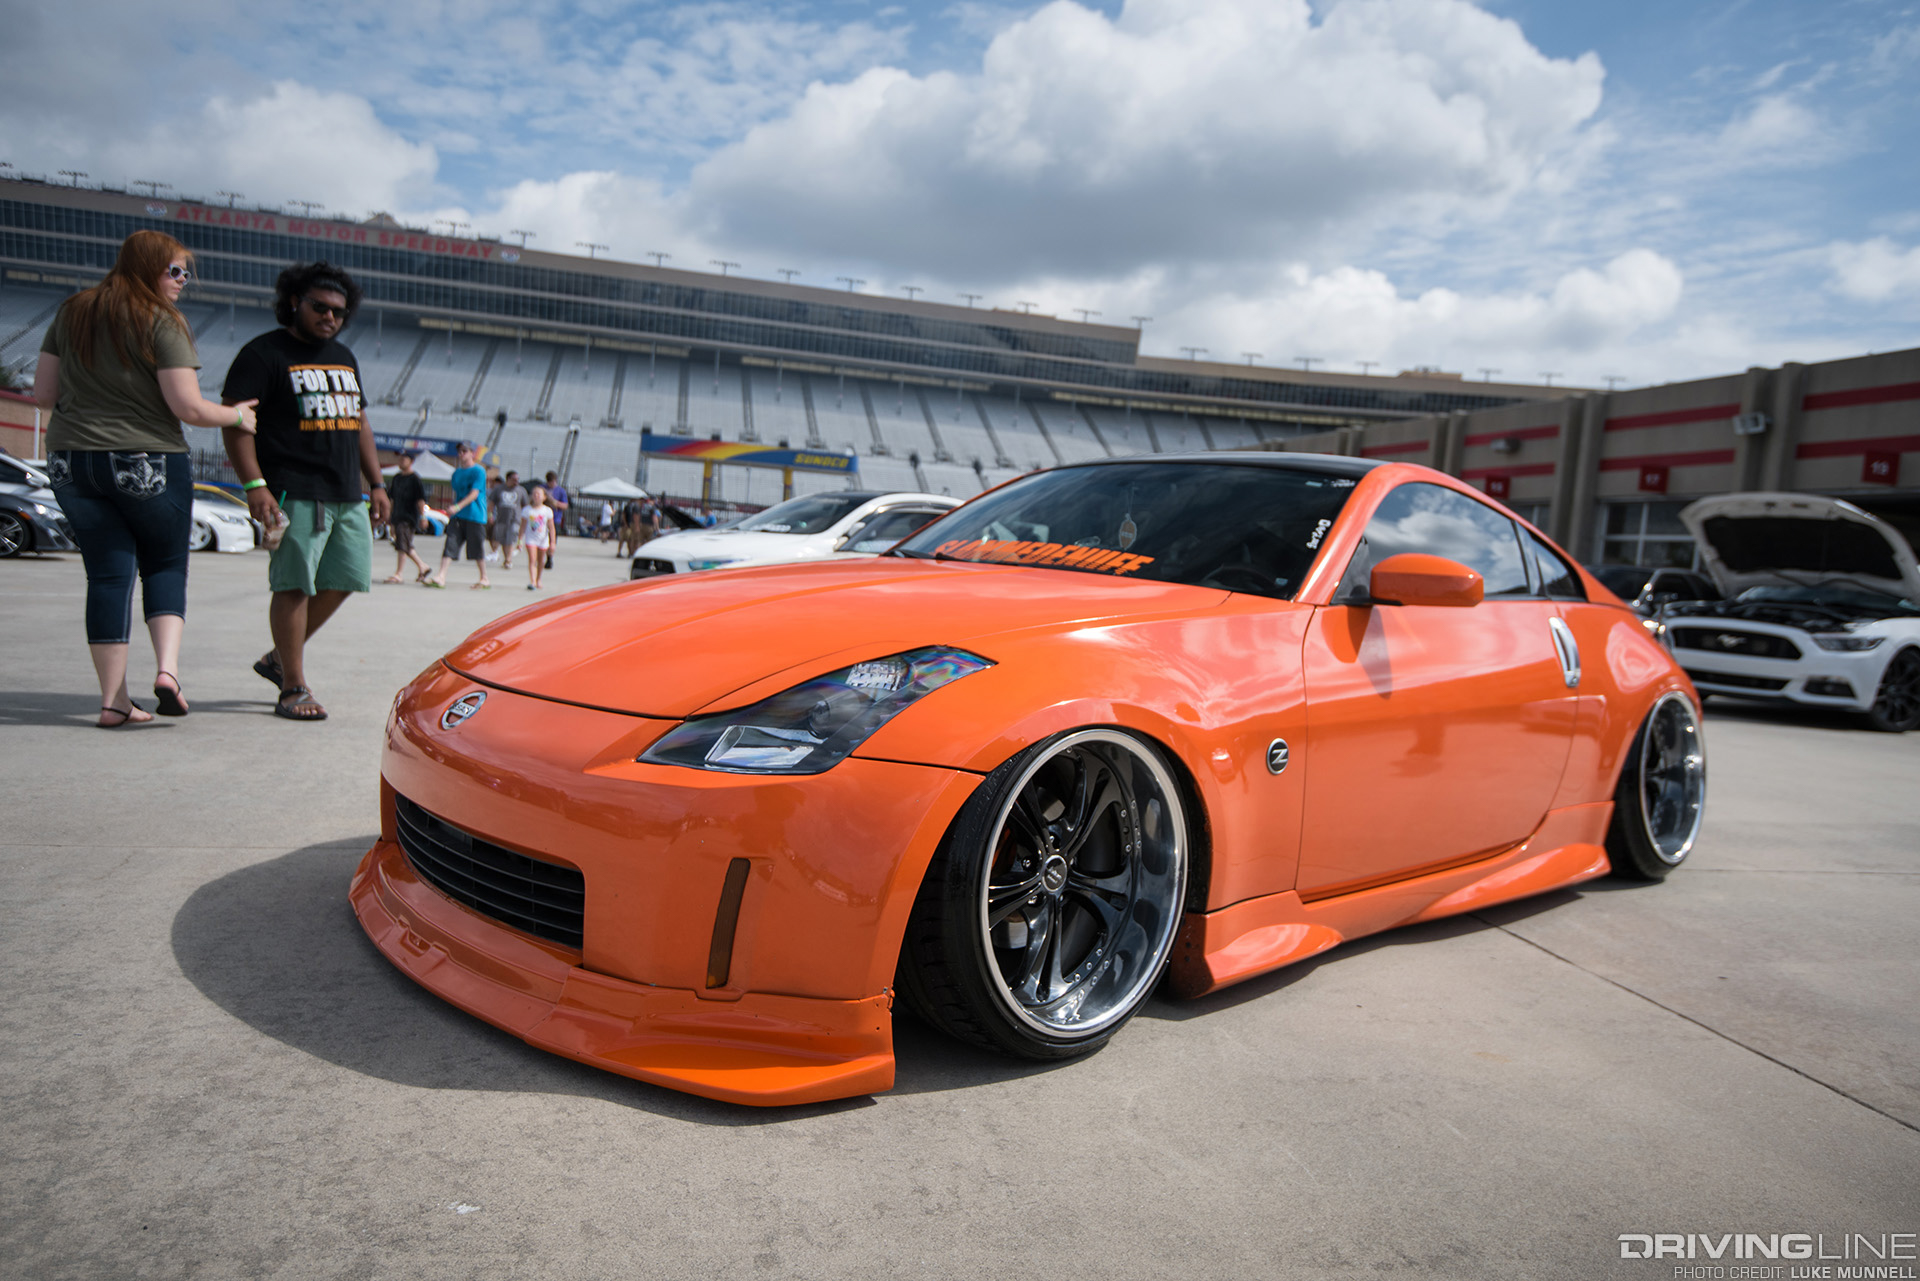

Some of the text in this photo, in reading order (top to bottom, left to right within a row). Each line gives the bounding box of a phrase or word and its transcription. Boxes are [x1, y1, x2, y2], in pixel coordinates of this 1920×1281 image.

[176, 205, 495, 258] ATLANTA MOTOR SPEEDWAY
[290, 369, 329, 394] FOR
[303, 394, 361, 418] PEOPLE
[794, 453, 849, 468] SUNOCO
[1271, 748, 1288, 764] Z
